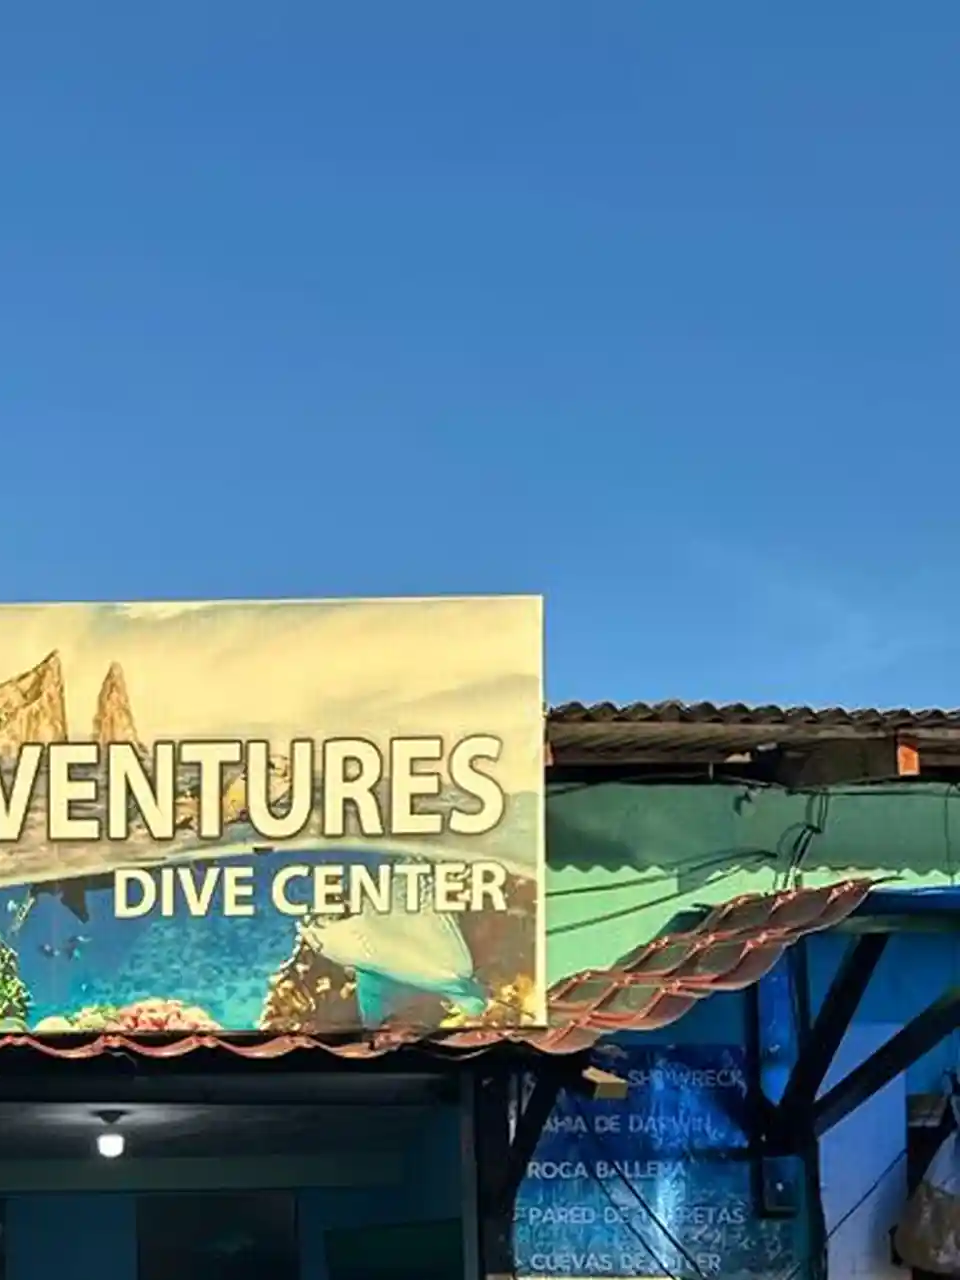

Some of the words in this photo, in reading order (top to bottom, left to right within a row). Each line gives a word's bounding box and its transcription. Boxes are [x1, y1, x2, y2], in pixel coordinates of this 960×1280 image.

[113, 863, 255, 919] DIVE
[271, 860, 510, 916] CENTER
[595, 1115, 621, 1133] DE
[528, 1161, 588, 1179] ROCA
[529, 1207, 595, 1226] PARED
[530, 1254, 612, 1272] CUEVAS
